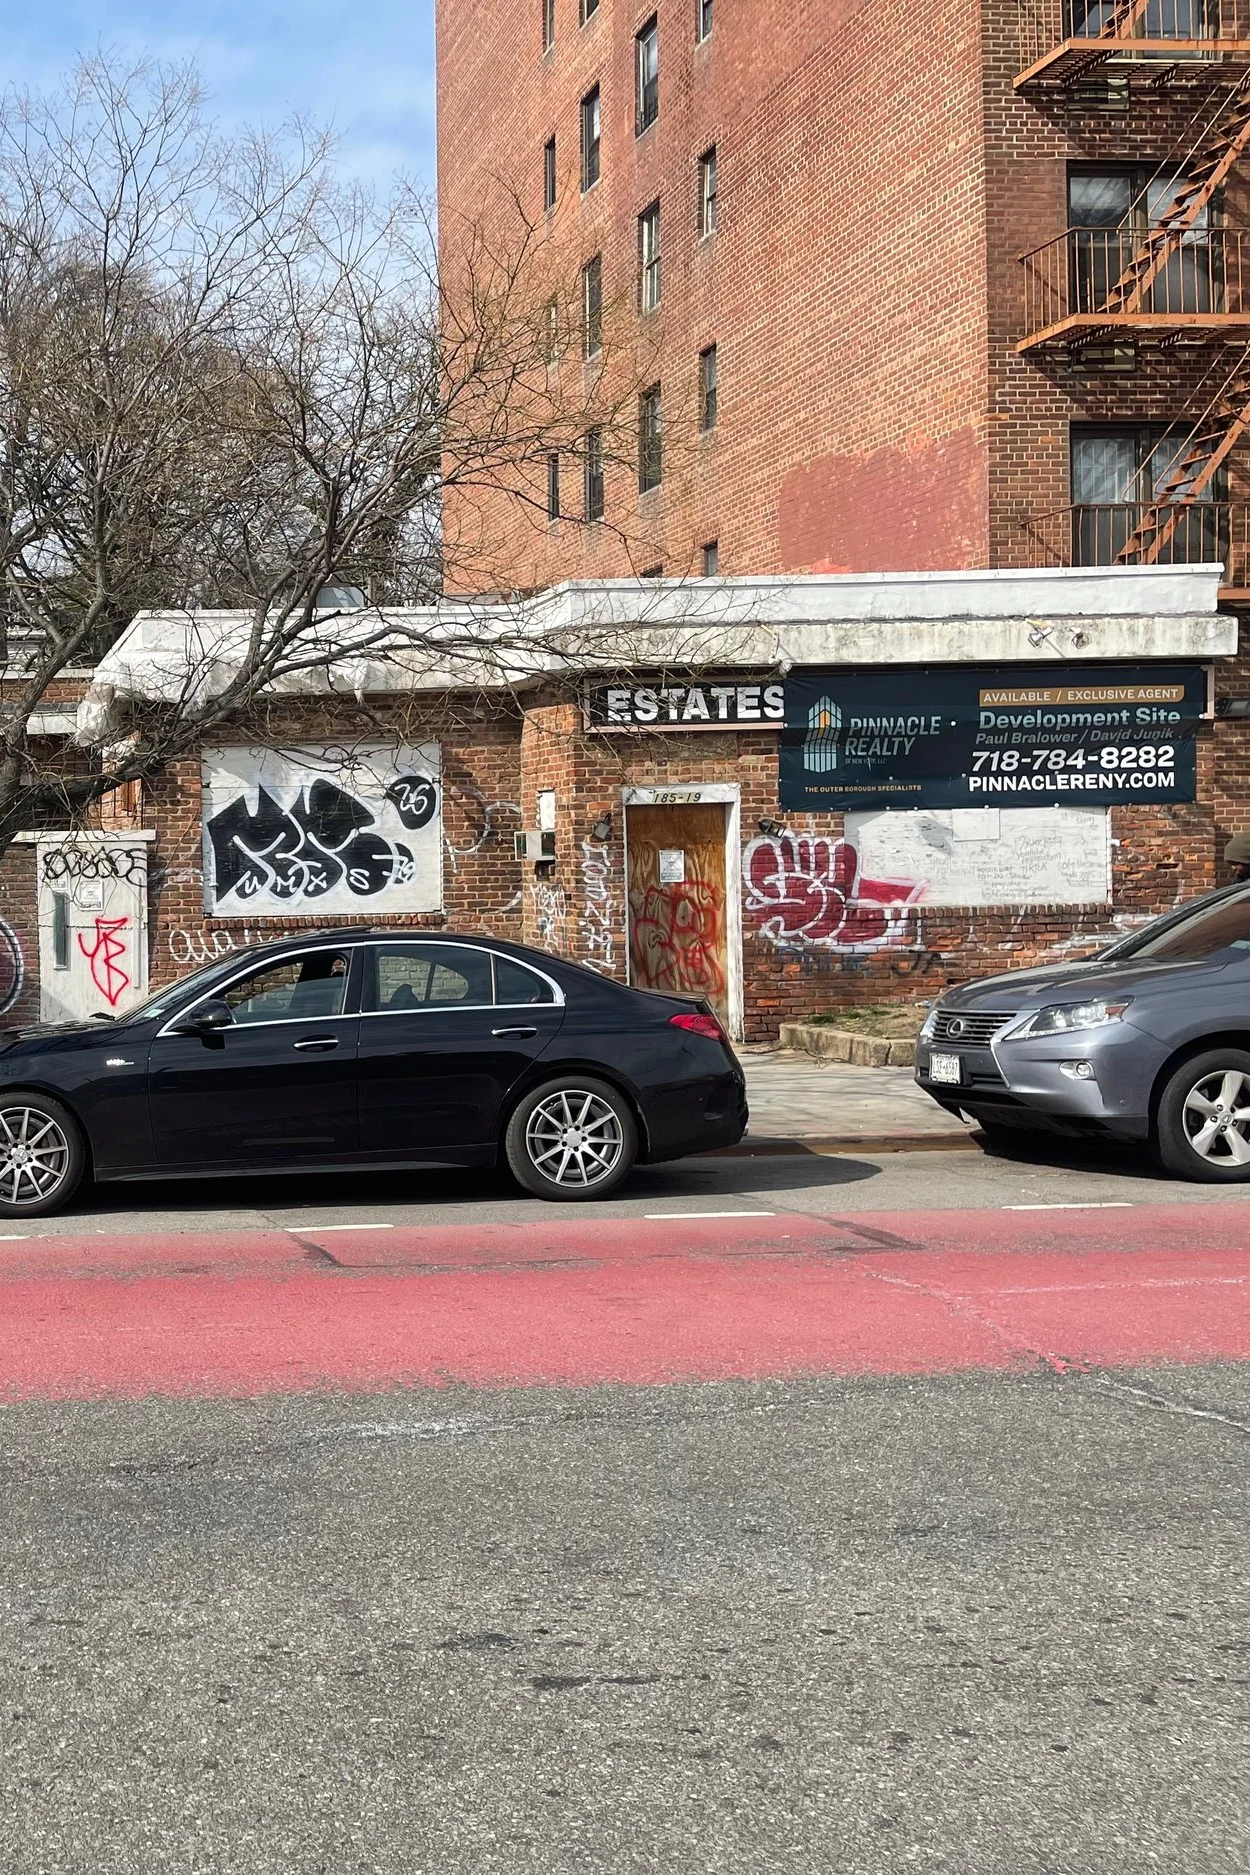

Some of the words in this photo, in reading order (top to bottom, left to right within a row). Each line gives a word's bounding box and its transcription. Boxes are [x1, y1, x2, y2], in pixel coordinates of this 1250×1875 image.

[607, 685, 785, 722] ESTATES
[983, 691, 1051, 702] AVAILABLE
[1056, 689, 1062, 702] /
[1067, 689, 1135, 701] EXCLUSIVE
[1137, 688, 1179, 699] AGENT
[848, 715, 942, 736] PINNACLE
[979, 707, 1130, 731] Development
[1135, 706, 1181, 726] Site
[844, 736, 916, 756] REALTY
[975, 731, 1008, 745] Paul
[1011, 730, 1078, 744] Bralower
[1078, 729, 1089, 744] /
[1090, 728, 1130, 743] David
[971, 745, 1175, 772] 718-784-8282
[819, 785, 844, 793] OUTER
[877, 784, 922, 792] SPECIALISTS
[968, 772, 1175, 792] PINNACLERENY.COM
[653, 792, 702, 804] 185-19
